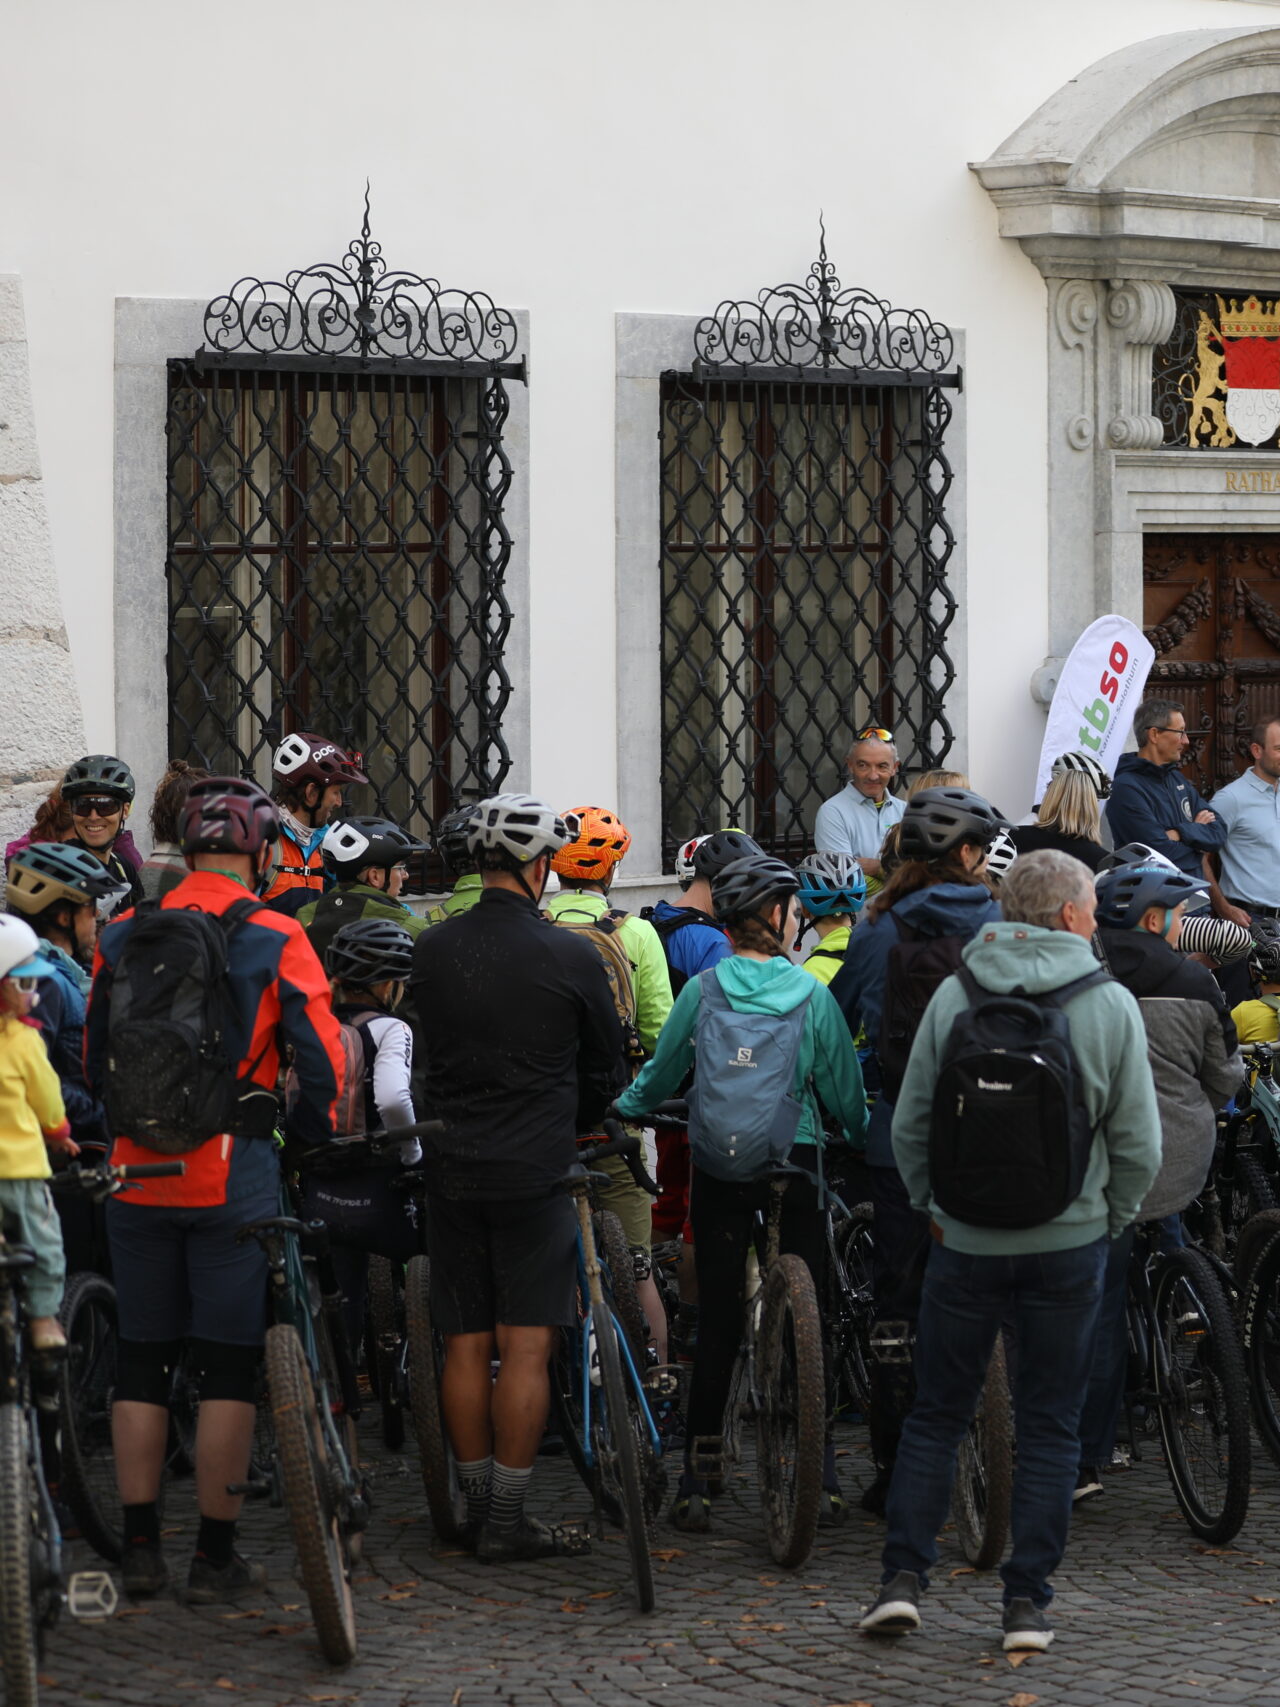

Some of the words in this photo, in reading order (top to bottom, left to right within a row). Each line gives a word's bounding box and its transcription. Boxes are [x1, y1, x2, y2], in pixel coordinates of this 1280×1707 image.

[1077, 641, 1128, 756] tbso
[1115, 657, 1140, 714] Solothurn
[1244, 1283, 1260, 1349] MAXXIS
